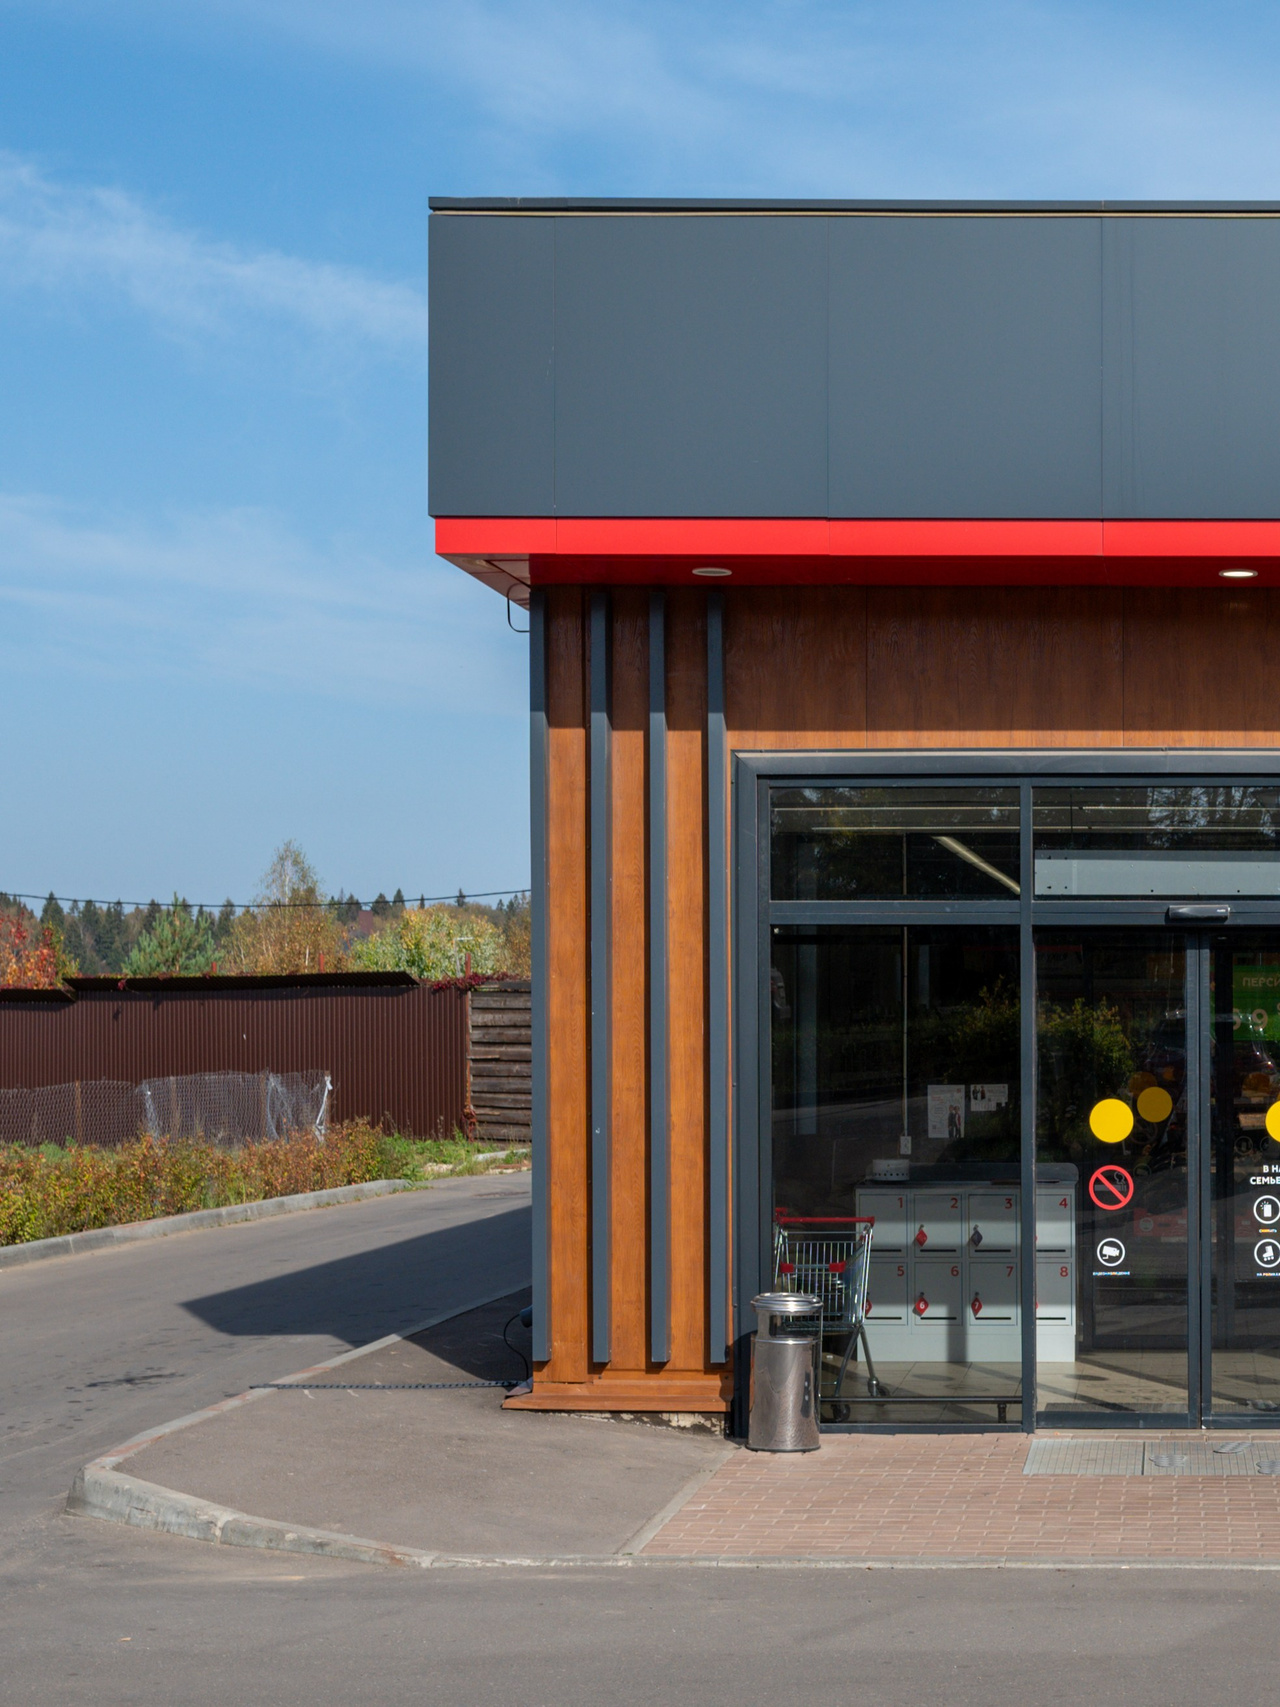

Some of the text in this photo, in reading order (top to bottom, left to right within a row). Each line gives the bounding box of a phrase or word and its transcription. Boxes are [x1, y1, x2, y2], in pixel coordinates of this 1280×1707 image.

[1262, 1165, 1269, 1173] В
[1249, 1176, 1280, 1185] СЕМЬЕ
[897, 1197, 903, 1208] 1
[950, 1197, 958, 1209] 2
[1005, 1198, 1013, 1209] 3
[1059, 1197, 1068, 1208] 4
[897, 1265, 905, 1276] 5
[951, 1265, 959, 1277] 6
[1006, 1266, 1014, 1277] 7
[1060, 1266, 1069, 1277] 8
